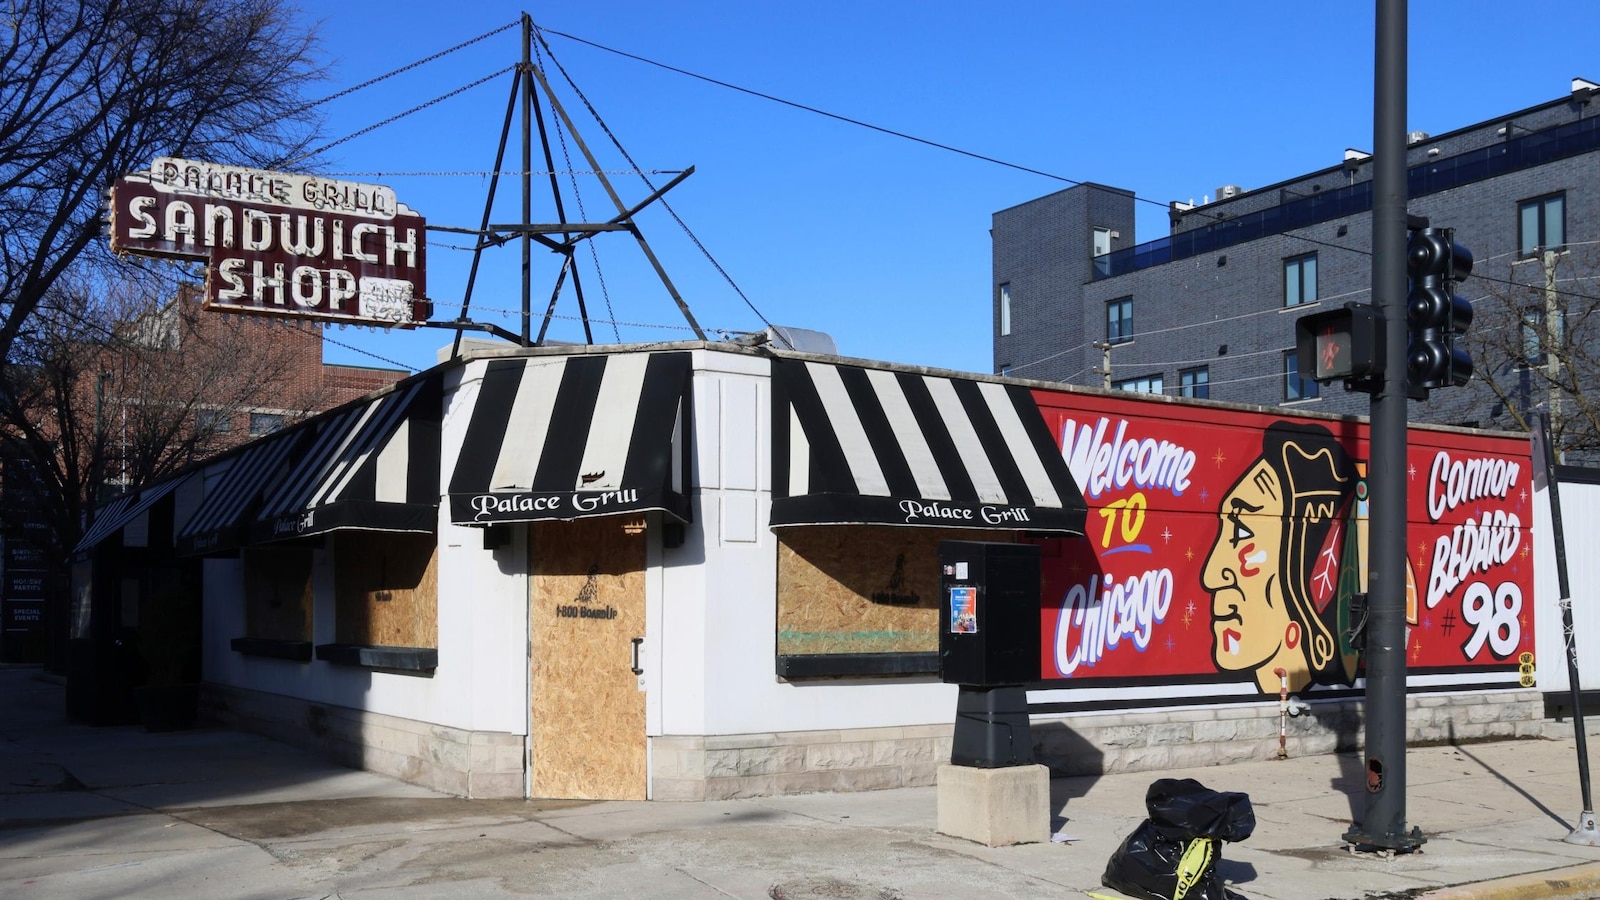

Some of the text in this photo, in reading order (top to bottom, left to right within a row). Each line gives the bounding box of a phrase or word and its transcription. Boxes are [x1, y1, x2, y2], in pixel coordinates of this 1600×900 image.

[163, 162, 392, 217] PALACE GRILL
[128, 196, 417, 267] SANDWICH
[218, 258, 356, 310] SHOP
[1061, 417, 1197, 498] Welcome
[1428, 451, 1520, 522] Connor
[471, 489, 639, 522] Palace Grill
[899, 500, 1031, 525] Palace Grill
[1099, 492, 1147, 549] TO
[1426, 510, 1521, 609] BEDARD
[1054, 567, 1174, 678] Chicago
